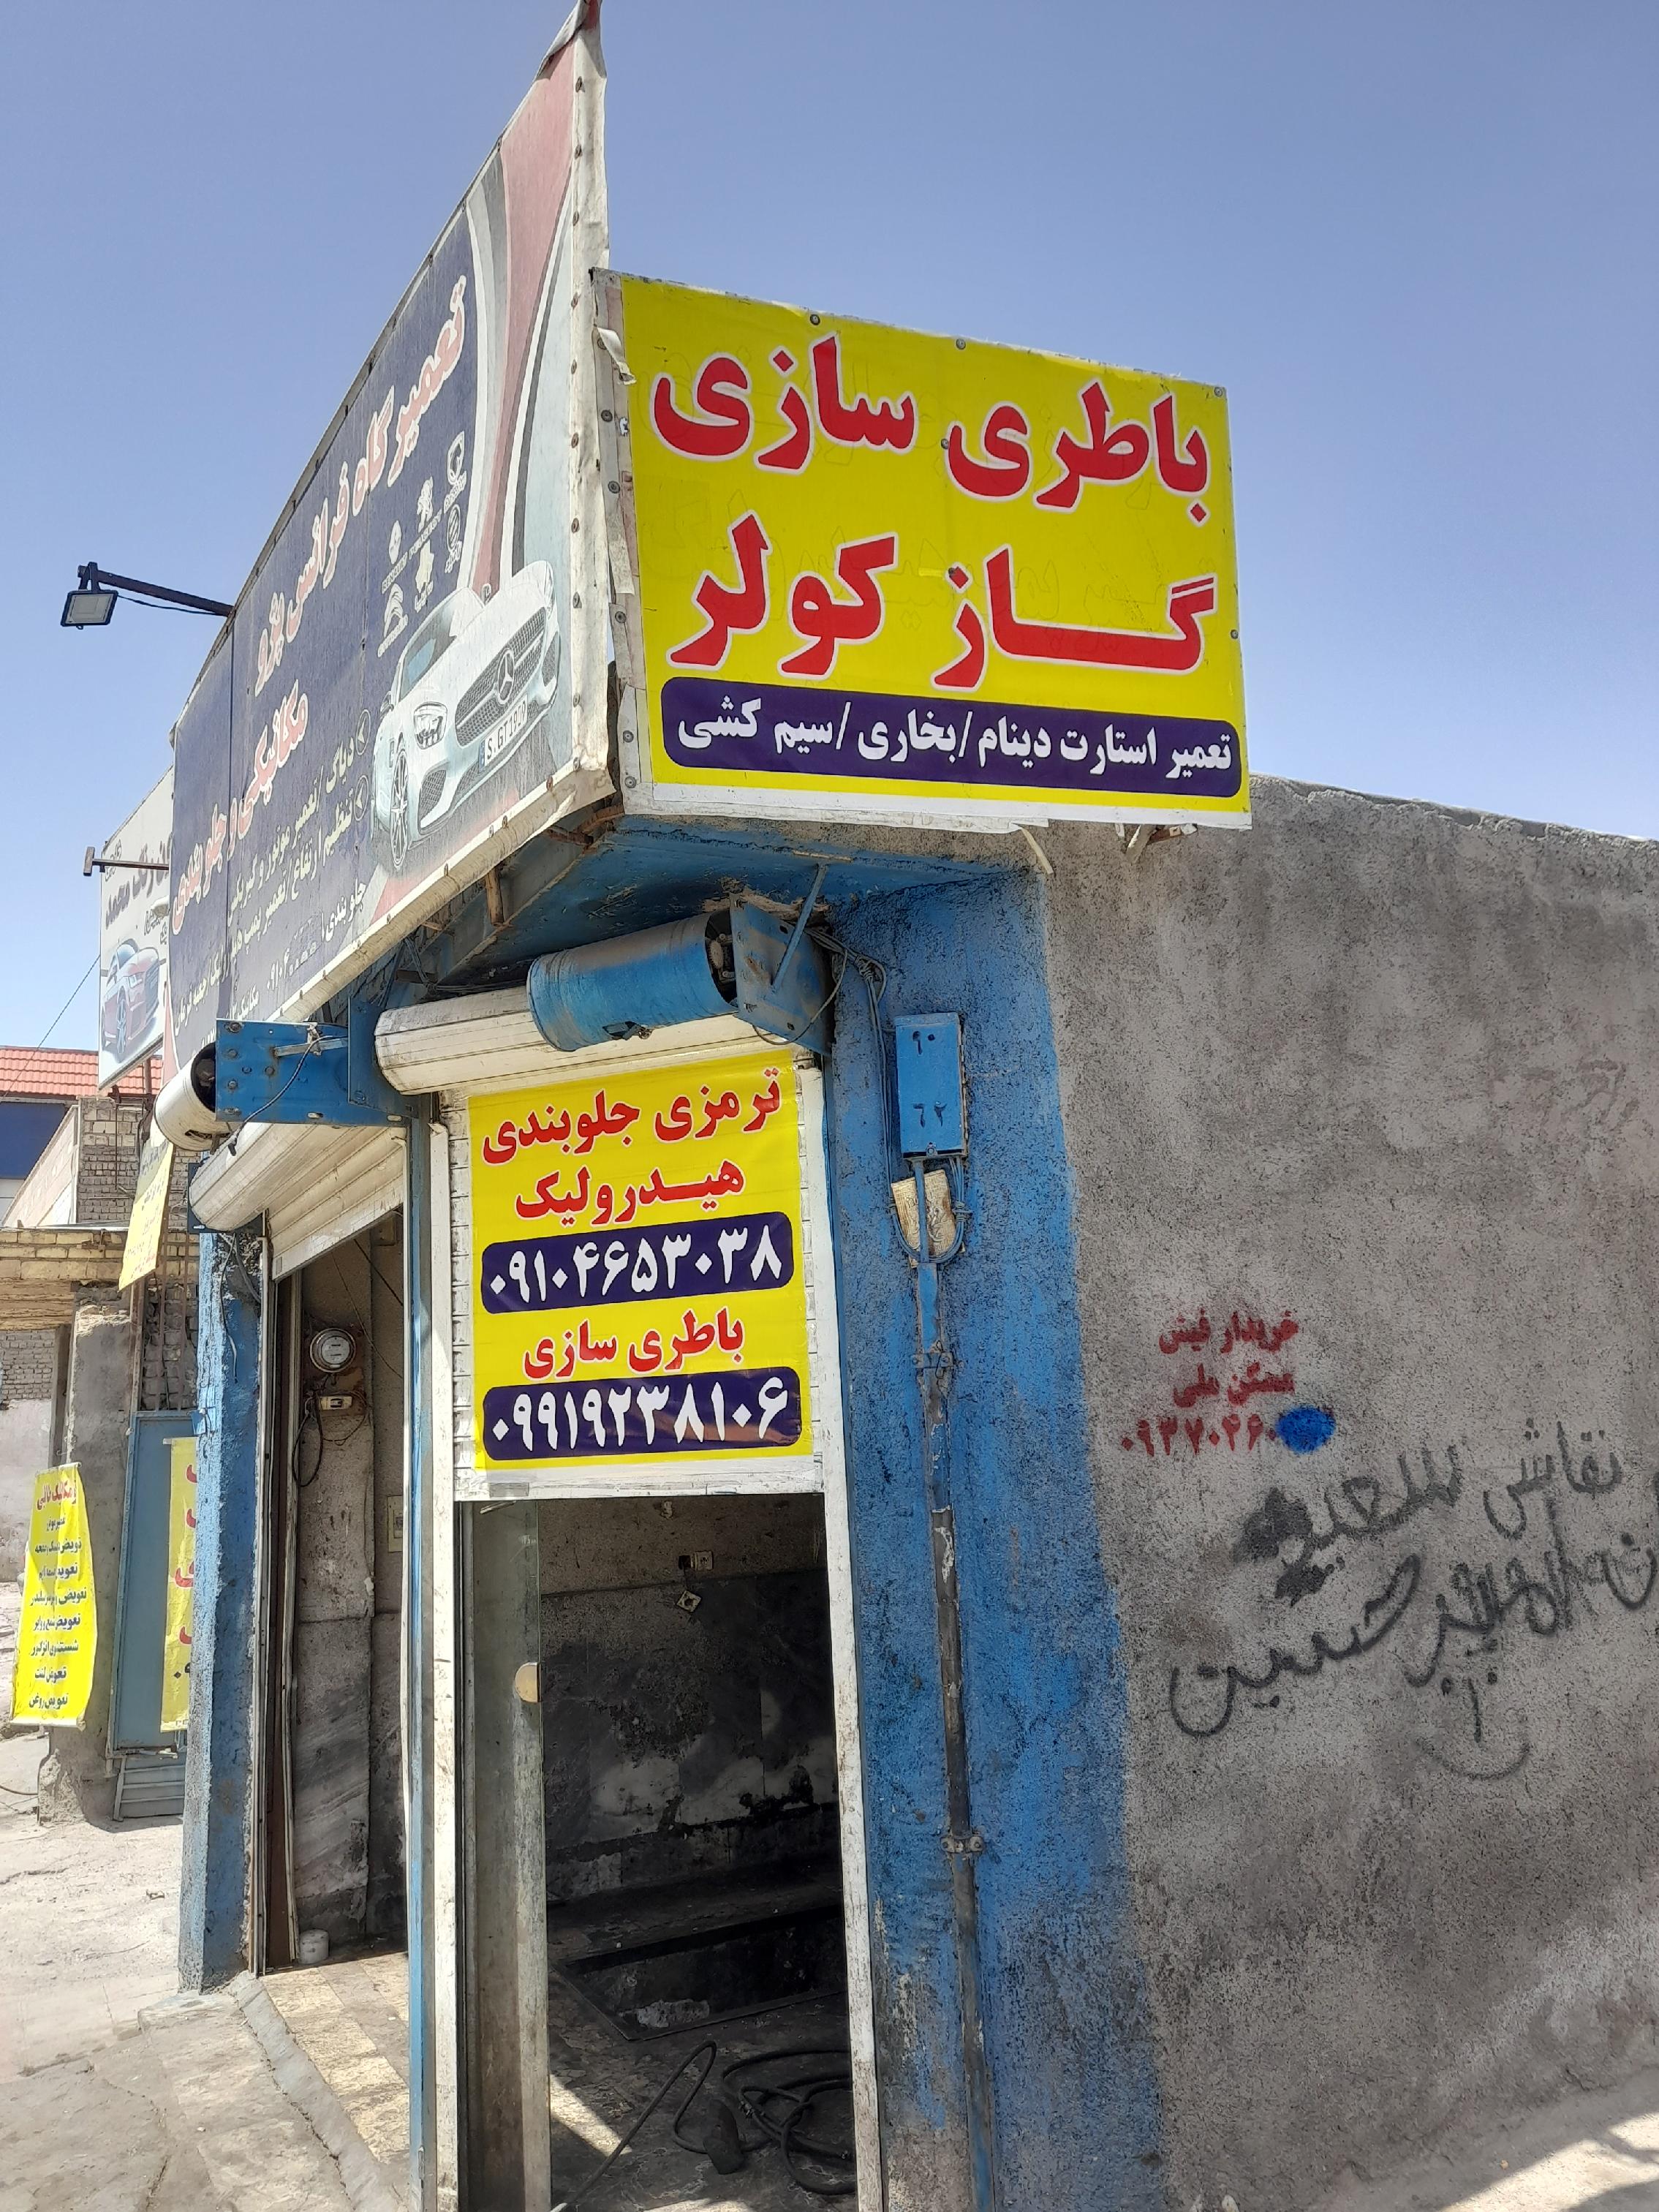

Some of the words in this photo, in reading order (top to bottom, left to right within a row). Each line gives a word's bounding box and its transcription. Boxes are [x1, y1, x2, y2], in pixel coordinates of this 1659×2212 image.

[652, 334, 915, 472] سازی
[946, 381, 1209, 524] باطری
[668, 514, 897, 676] کولر
[931, 544, 1216, 690] گاز
[678, 695, 762, 749] کشی
[1059, 723, 1157, 775] استارت
[1165, 733, 1233, 780] تعمیر
[654, 1067, 780, 1141] ترمزی
[515, 1160, 745, 1227] هیدرولیک
[490, 1225, 782, 1304] ۰۹۱۰۴۶۵۳۰۳۸
[524, 1320, 617, 1379] سازی
[628, 1307, 744, 1373] باطری
[493, 1376, 789, 1452] ۰۹۹۱۹۲۳۸۱۰۶
